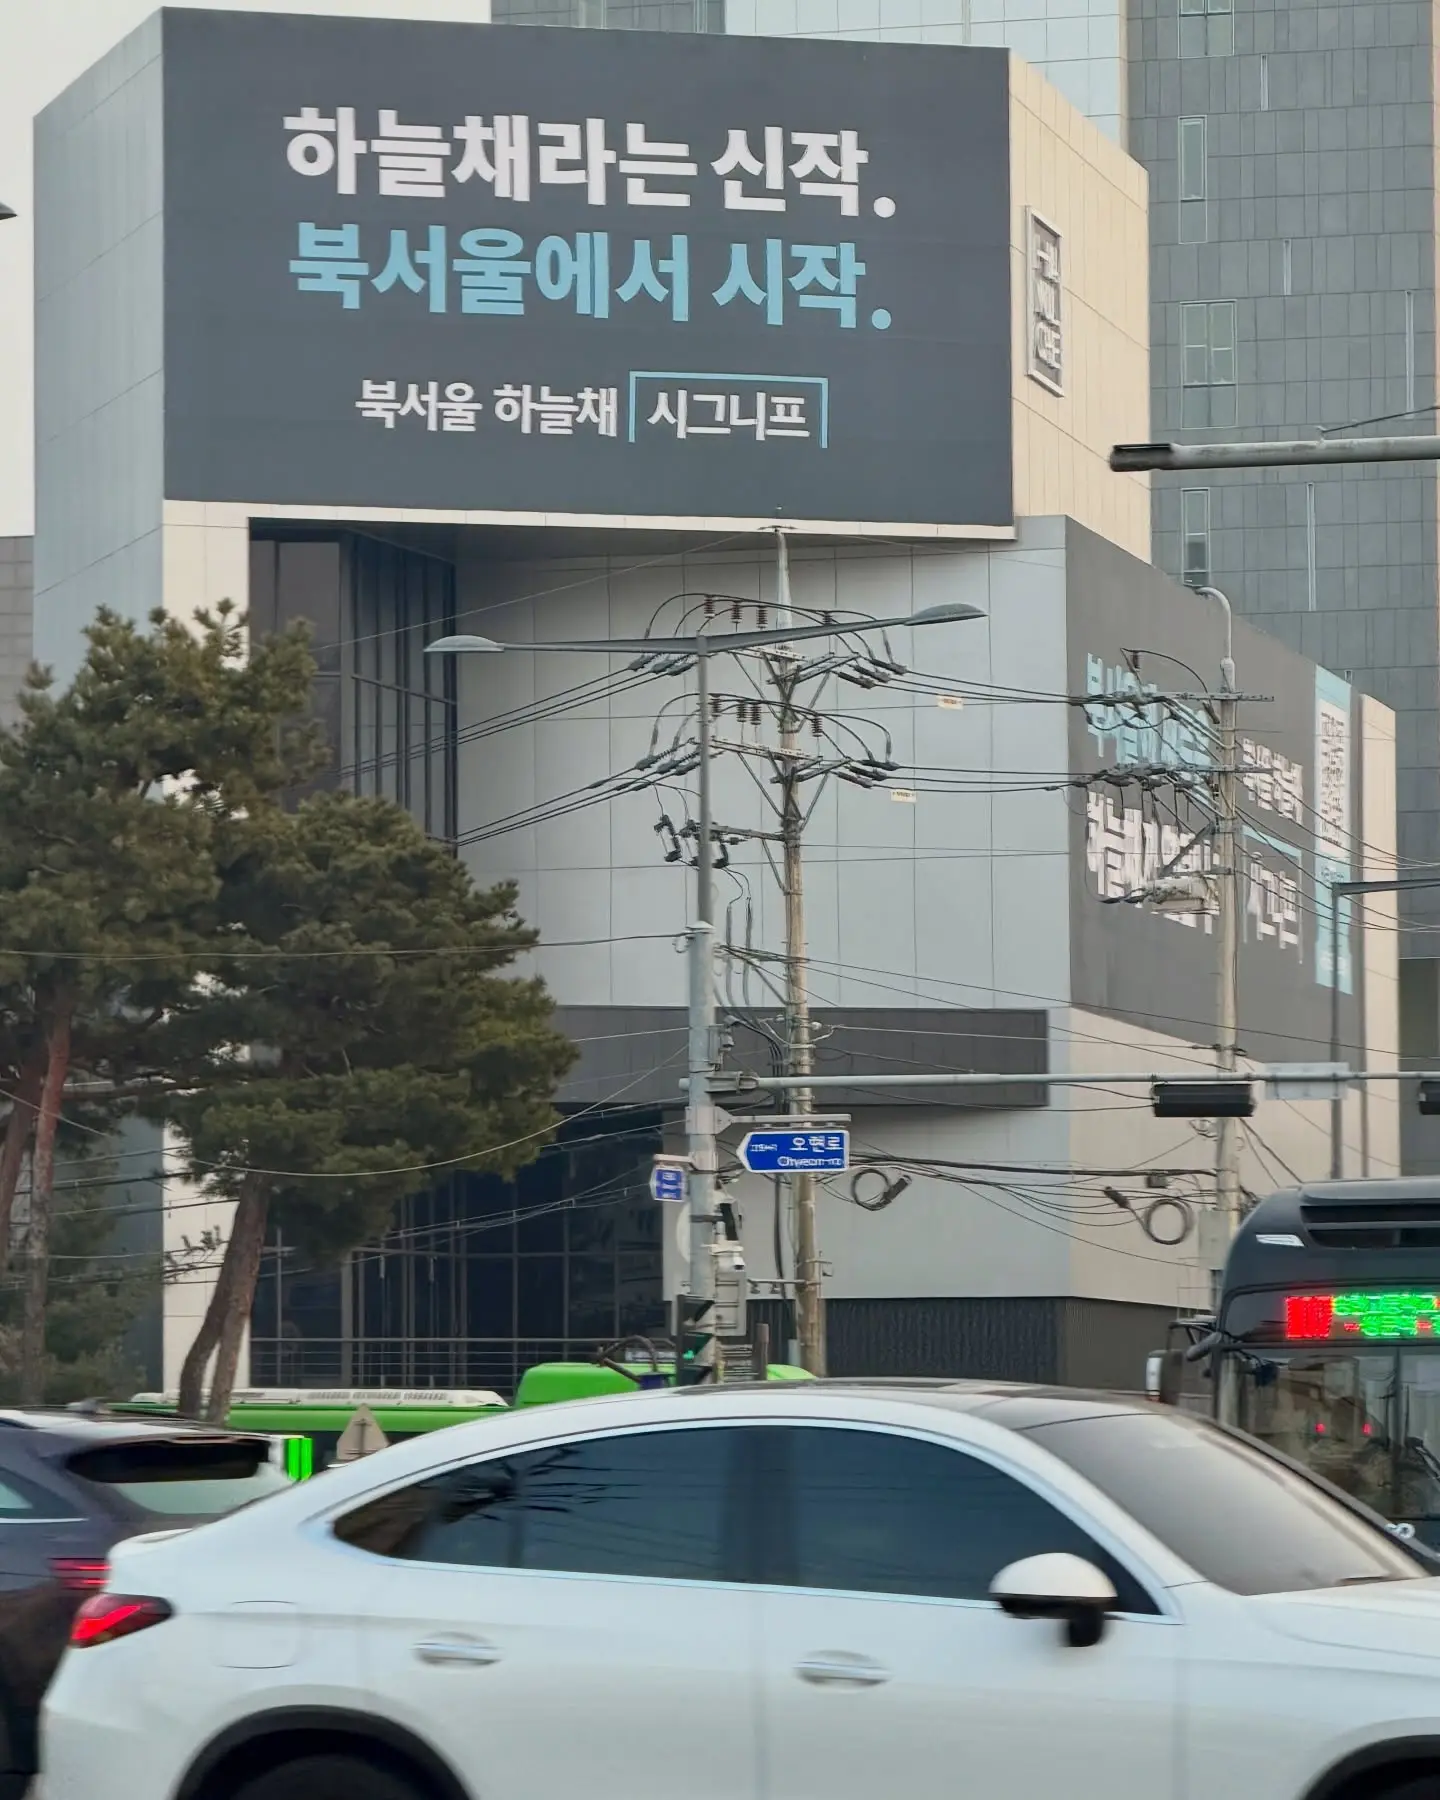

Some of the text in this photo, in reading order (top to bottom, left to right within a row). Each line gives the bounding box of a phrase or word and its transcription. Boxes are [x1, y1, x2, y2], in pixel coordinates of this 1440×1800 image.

[283, 107, 896, 218] 하늘채라는 신작.
[289, 222, 893, 329] 북서울에서 시작.
[355, 379, 810, 441] 북서울 하늘채 시그니프
[789, 1135, 844, 1153] 오현로
